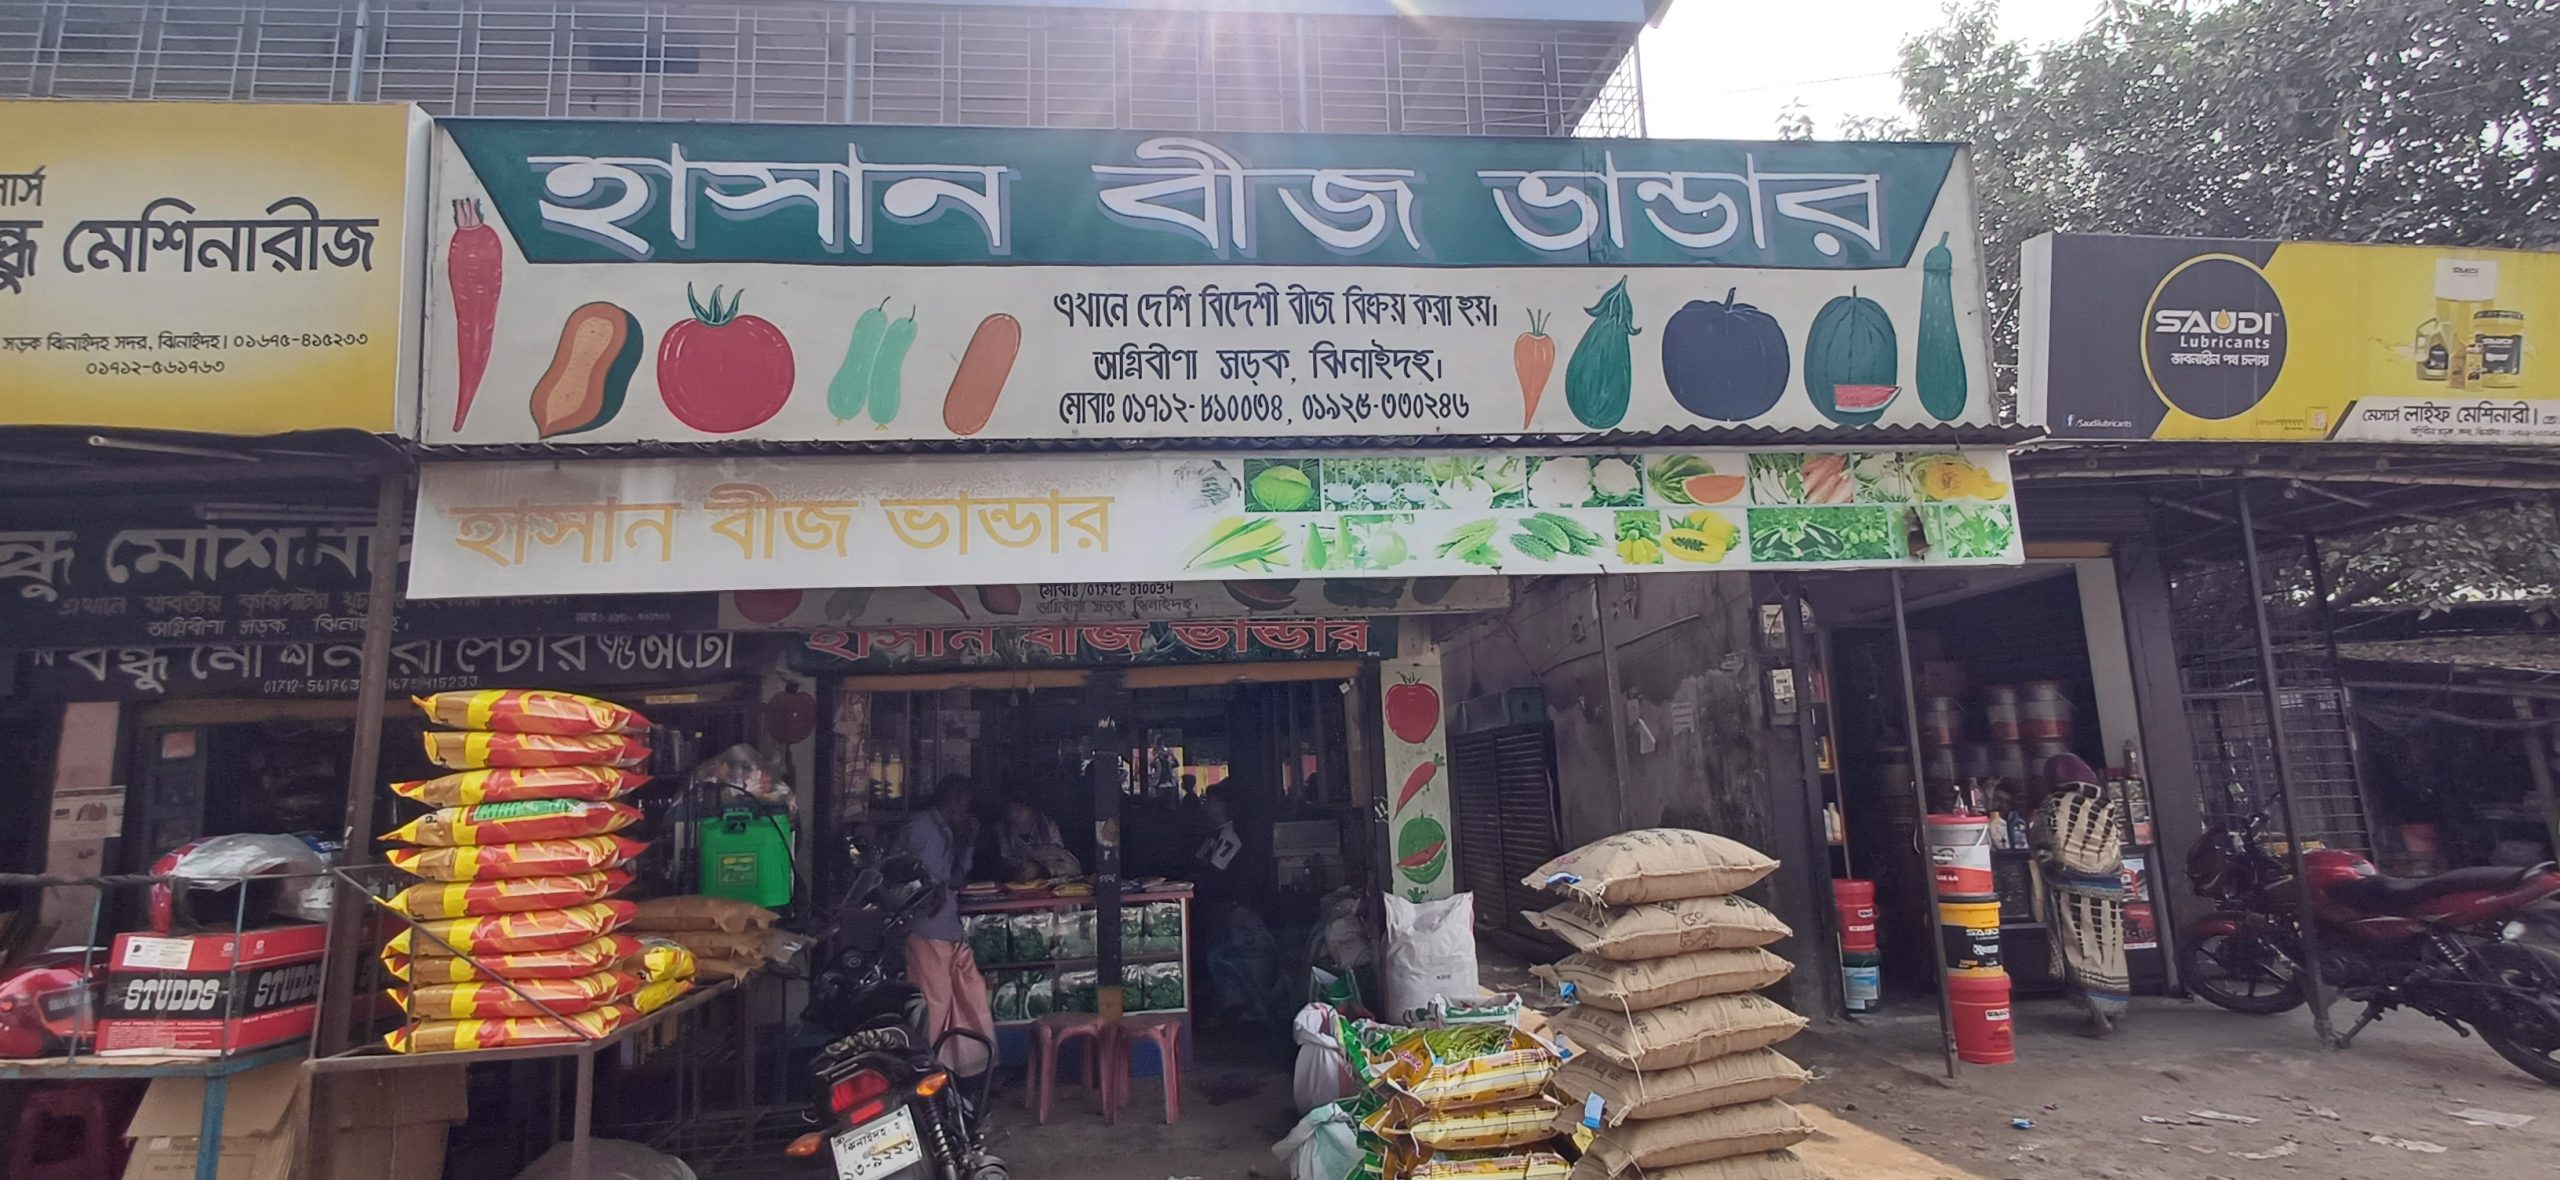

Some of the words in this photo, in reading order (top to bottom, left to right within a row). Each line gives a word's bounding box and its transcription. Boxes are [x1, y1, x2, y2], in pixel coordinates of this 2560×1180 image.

[527, 142, 1014, 258] হাসান
[1092, 138, 1422, 254] বীজ
[1478, 150, 1882, 256] ভান্ডার
[63, 196, 380, 274] মেশিনারীজ
[1054, 292, 1128, 327] এখানে
[1138, 285, 1192, 327] দেশি
[1199, 282, 1279, 327] বিদেশী
[1285, 283, 1335, 325] বীজ
[1343, 285, 1406, 325] বিক্রয়
[1409, 294, 1452, 326] করা
[1455, 295, 1498, 327] হয়।
[2155, 309, 2272, 335] SAUDI
[2, 336, 42, 352] সড়ক
[47, 332, 110, 352] ঝিনাইদহ
[114, 336, 152, 352] সদর,
[158, 331, 227, 351] ঝিনাইদহ।
[233, 334, 368, 349] ০১৬৭৫-৪১৫২৩৩
[2180, 335, 2270, 349] Lubricants
[86, 361, 225, 376] ০১৭১২-৫৬১৭৬৩
[1092, 342, 1198, 380] অগ্নিবীণা
[1216, 350, 1296, 386] সড়ক,
[1309, 339, 1442, 382] ঝিনাইদহ।
[1059, 392, 1115, 424] মোবাঃ
[2362, 407, 2400, 422] মেসার্স
[2403, 401, 2451, 423] লাইফ
[449, 497, 684, 567] হাসান
[704, 483, 860, 559] বীজ
[880, 489, 1115, 555] ভান্ডার
[124, 979, 220, 1011] STUDDS
